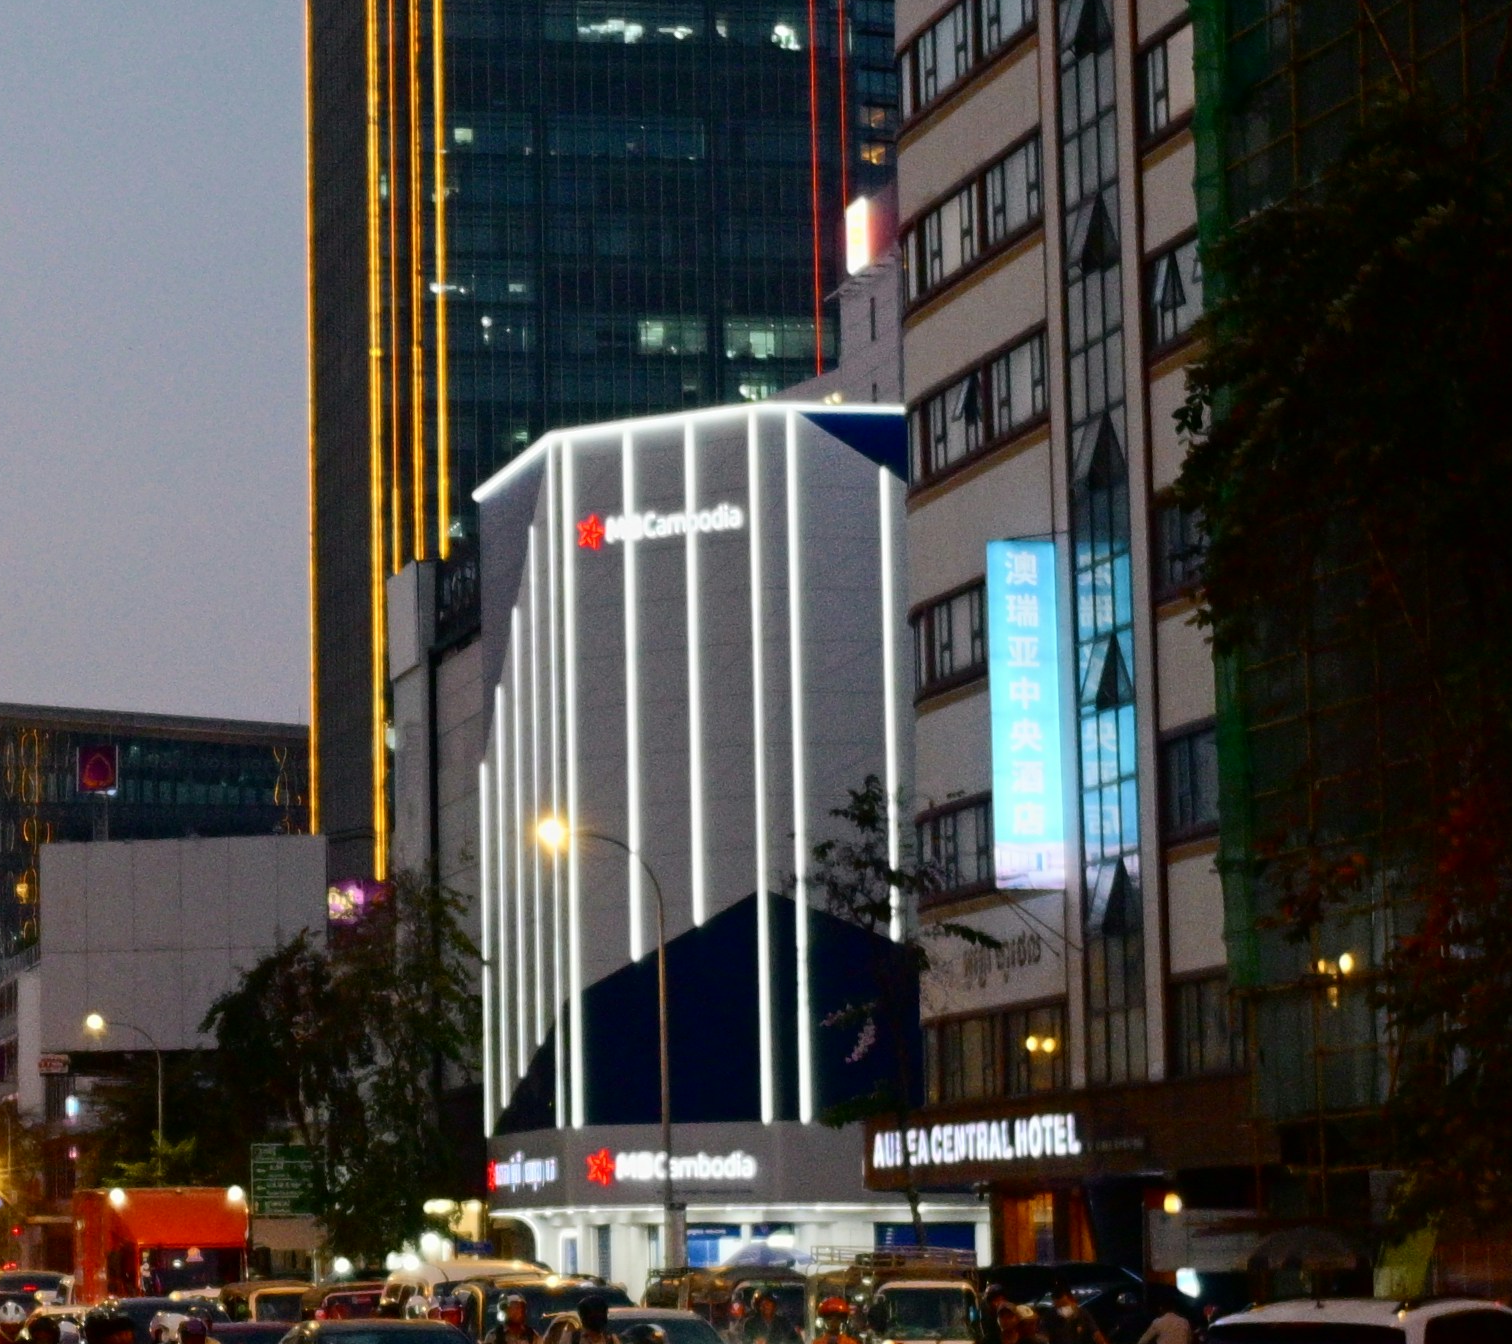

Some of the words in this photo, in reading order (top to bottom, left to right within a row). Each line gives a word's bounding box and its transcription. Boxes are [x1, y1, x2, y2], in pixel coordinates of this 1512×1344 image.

[1004, 551, 1046, 836] 澳瑞亚中央酒店
[930, 1119, 1013, 1165] CENTRAL
[1014, 1112, 1082, 1158] HOTEL
